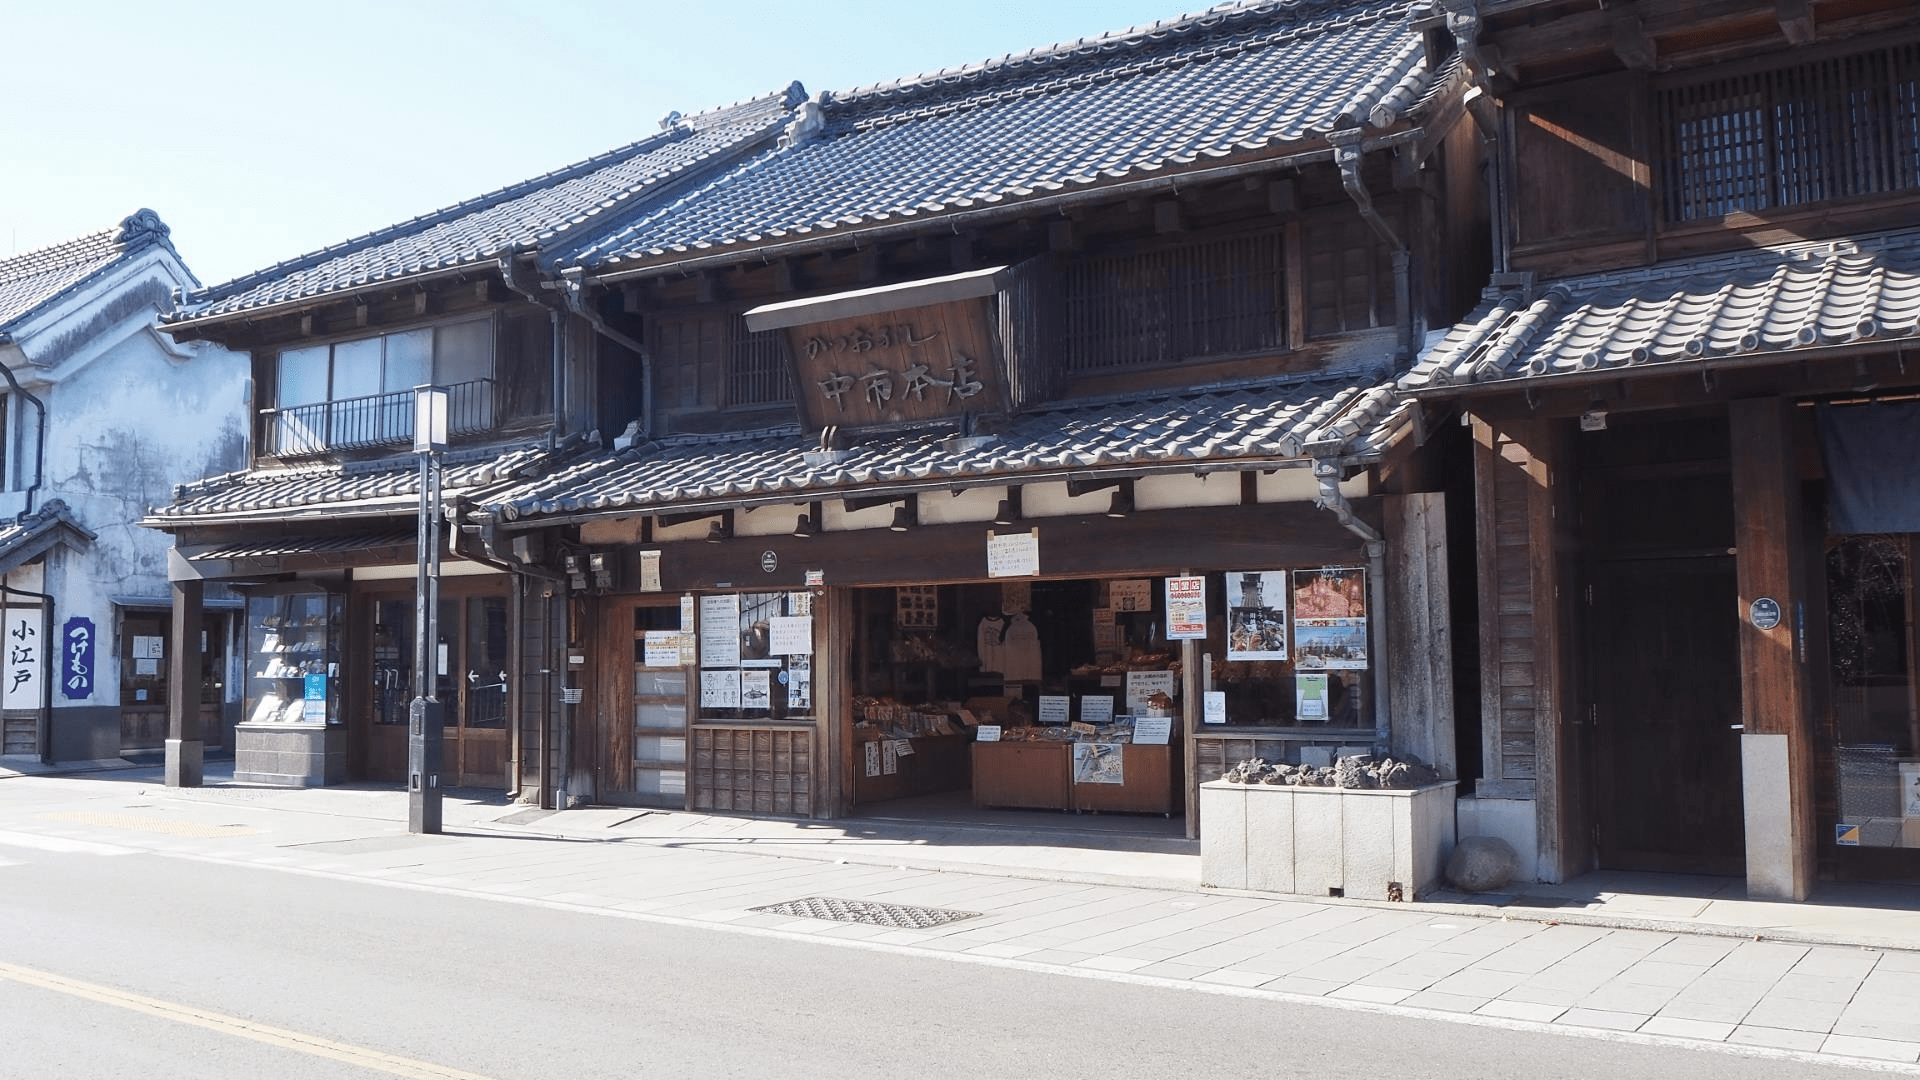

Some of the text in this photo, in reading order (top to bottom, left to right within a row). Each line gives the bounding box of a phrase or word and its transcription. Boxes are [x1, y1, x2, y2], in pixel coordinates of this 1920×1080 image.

[817, 354, 984, 412] 中市本店
[10, 620, 35, 694] 小江戸
[68, 626, 89, 690] つけもの
